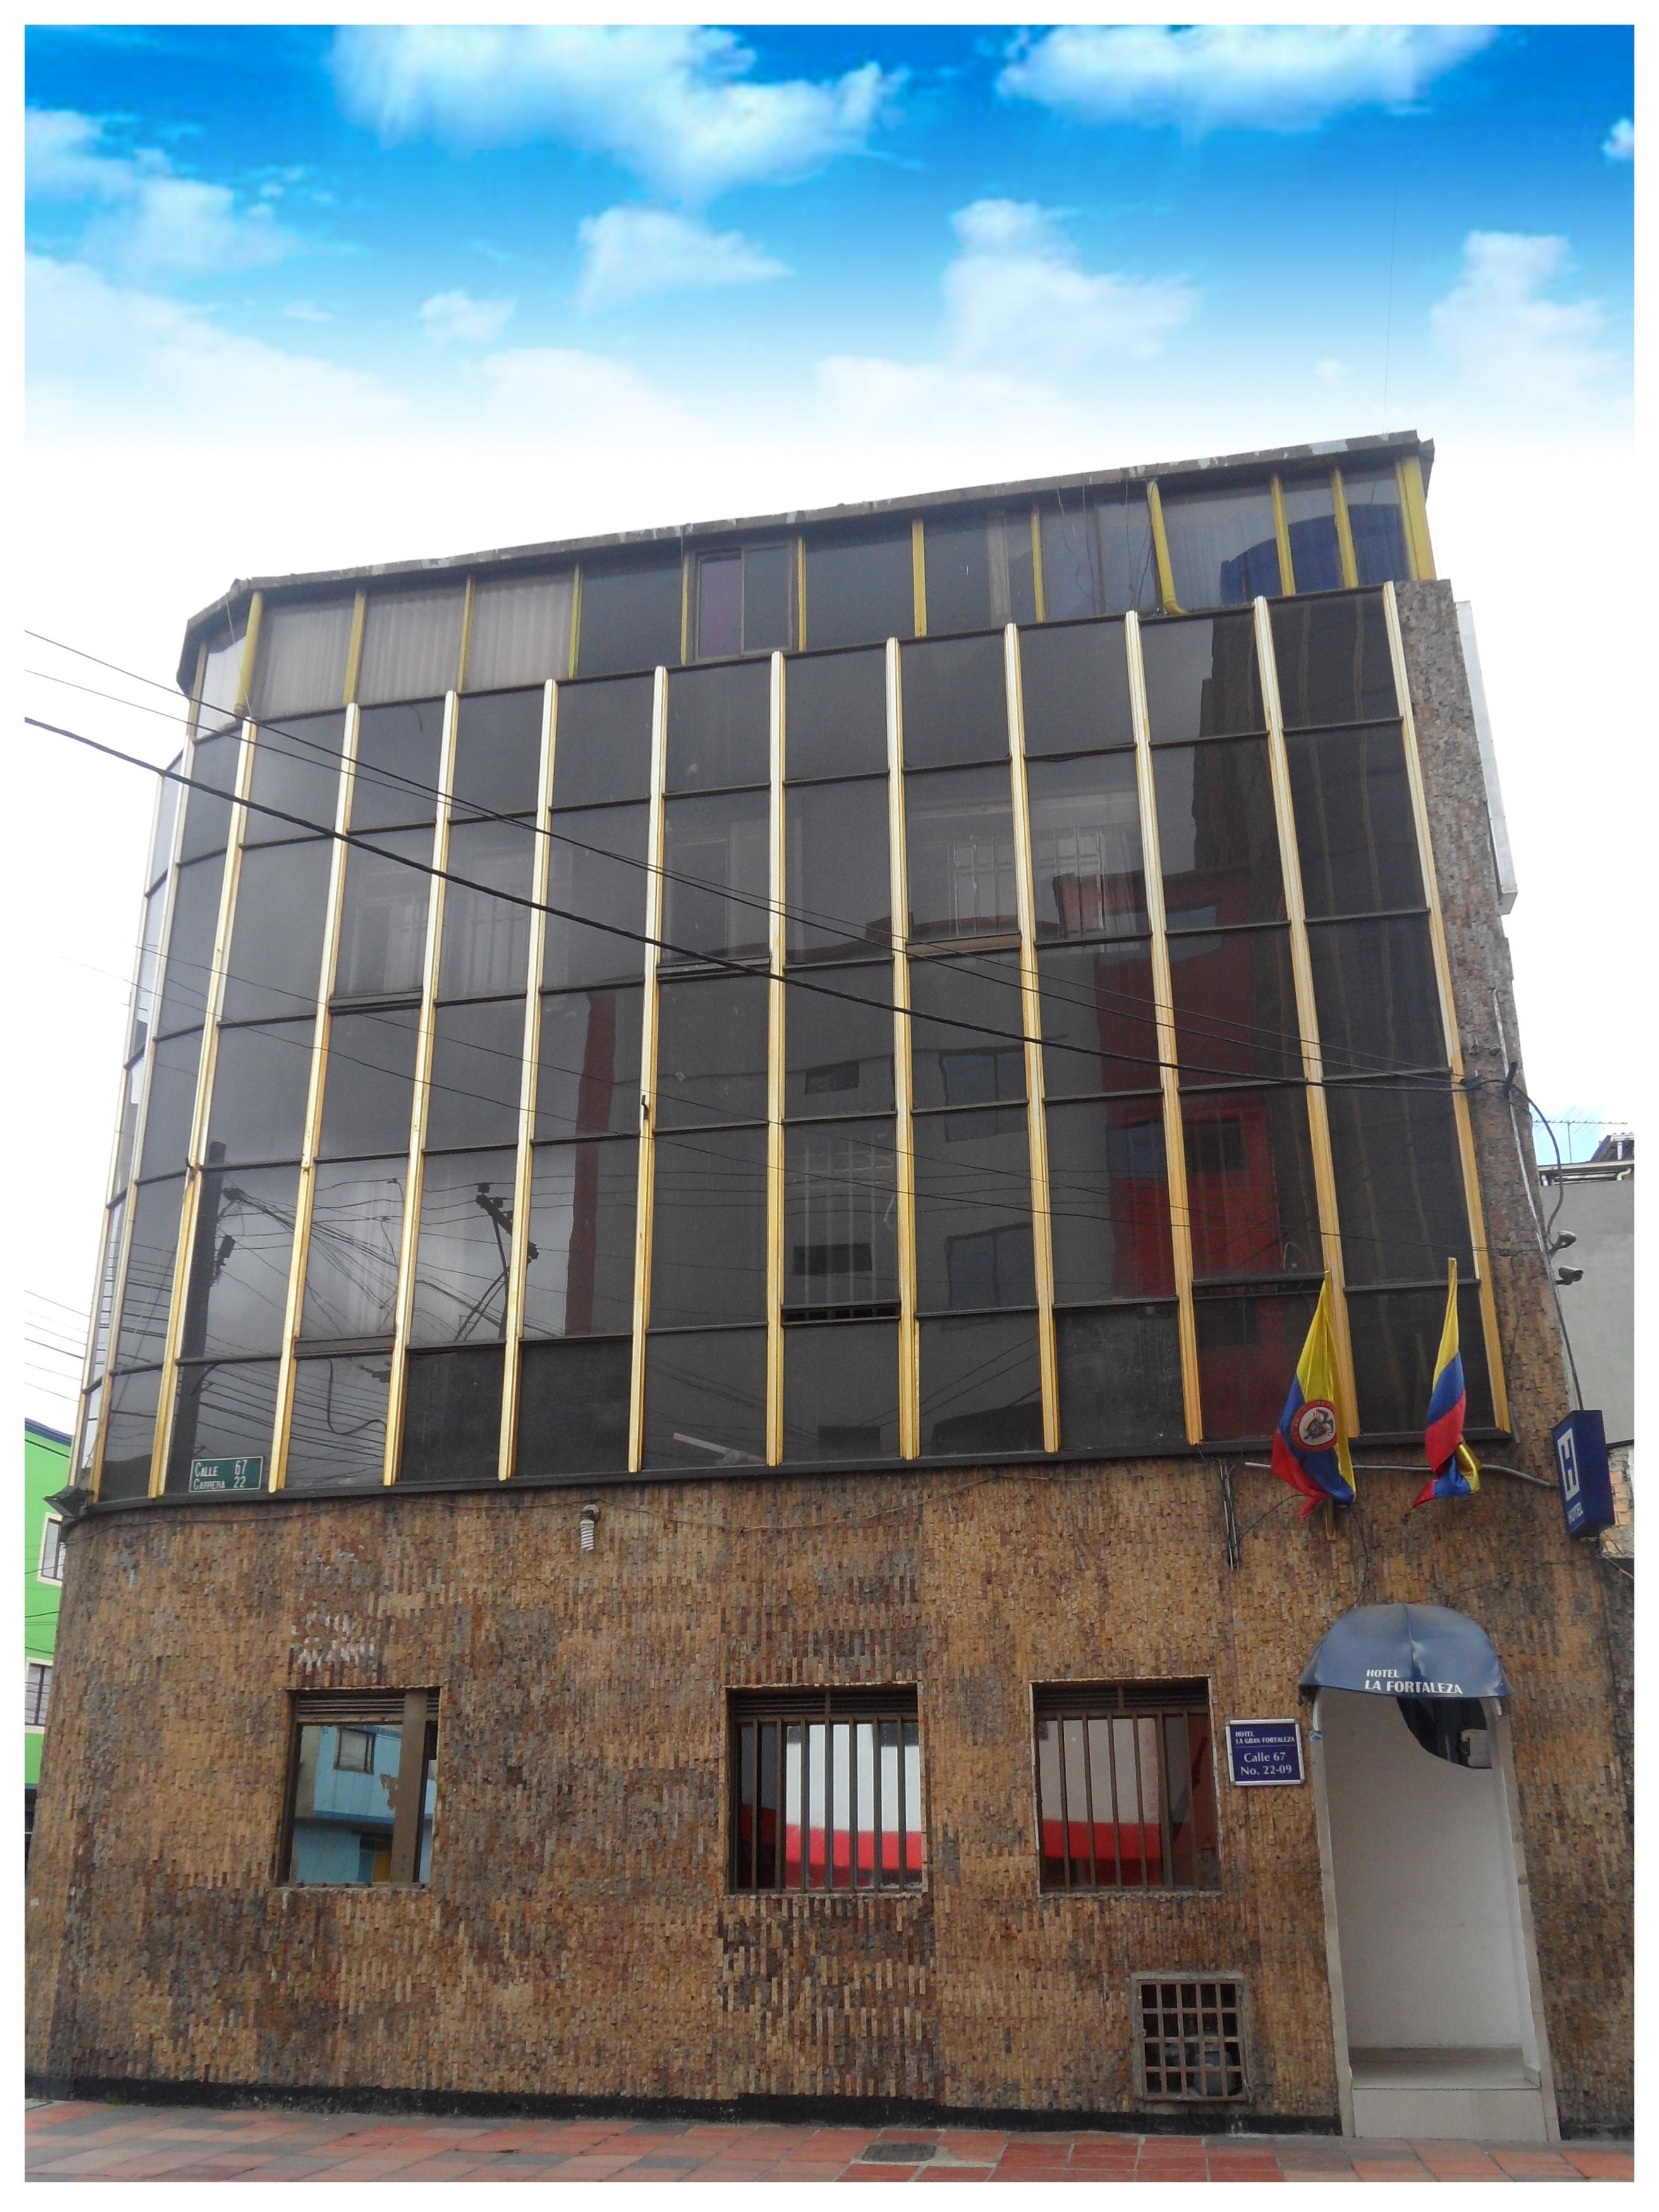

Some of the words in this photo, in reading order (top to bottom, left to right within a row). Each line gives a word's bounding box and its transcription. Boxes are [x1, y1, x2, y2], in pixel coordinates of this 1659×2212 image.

[195, 1462, 218, 1477] CALLE
[234, 1459, 247, 1475] 67
[1560, 1436, 1577, 1493] H
[193, 1478, 225, 1490] CARRERA
[233, 1476, 246, 1488] 22
[1366, 1669, 1400, 1678] HOTEL
[1364, 1680, 1381, 1691] LA
[1386, 1681, 1463, 1694] FORTALEZA
[1244, 1751, 1270, 1763] Calle
[1273, 1752, 1286, 1762] 67
[1240, 1766, 1260, 1776] No.
[1263, 1765, 1292, 1775] 22-09
